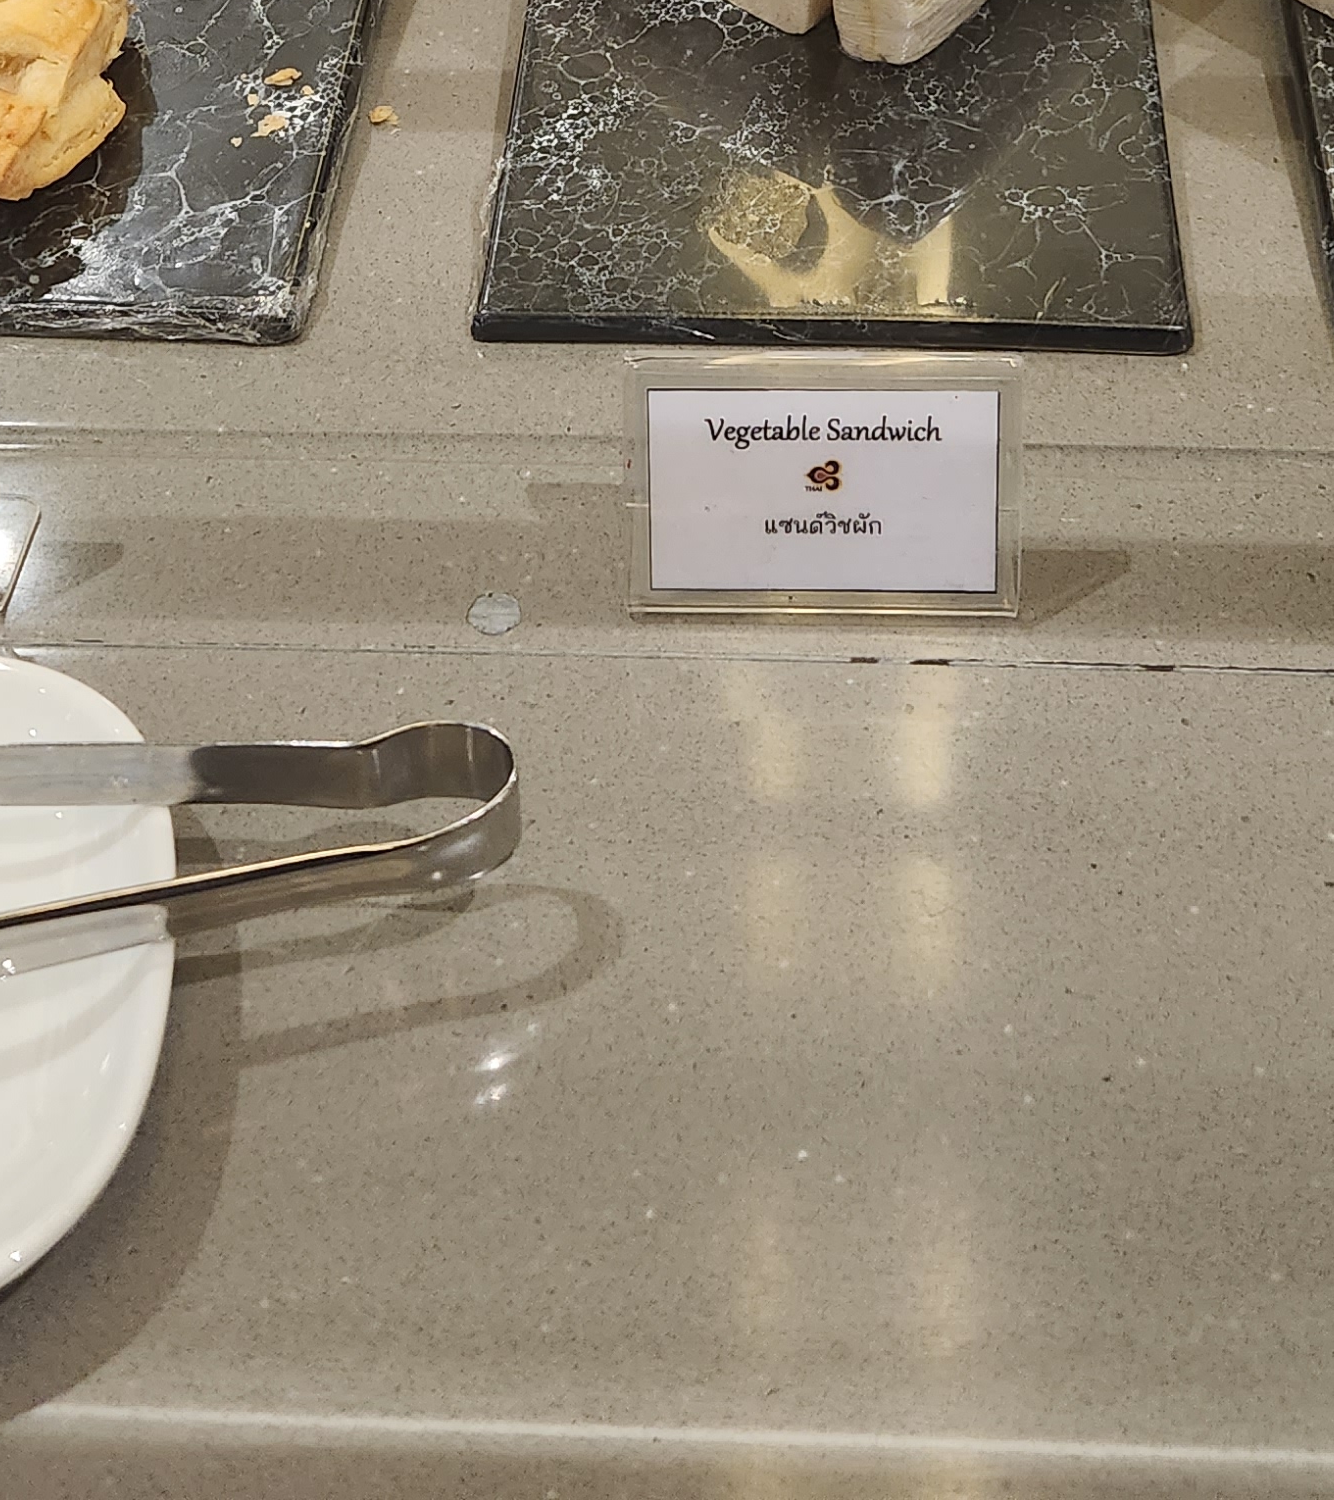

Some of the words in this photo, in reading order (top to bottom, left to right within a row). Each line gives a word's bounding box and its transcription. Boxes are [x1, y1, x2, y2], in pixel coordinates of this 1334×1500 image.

[704, 414, 821, 449] Vegetable
[826, 415, 942, 441] Sandwich
[764, 511, 882, 535] แซนด์วิชผัก
